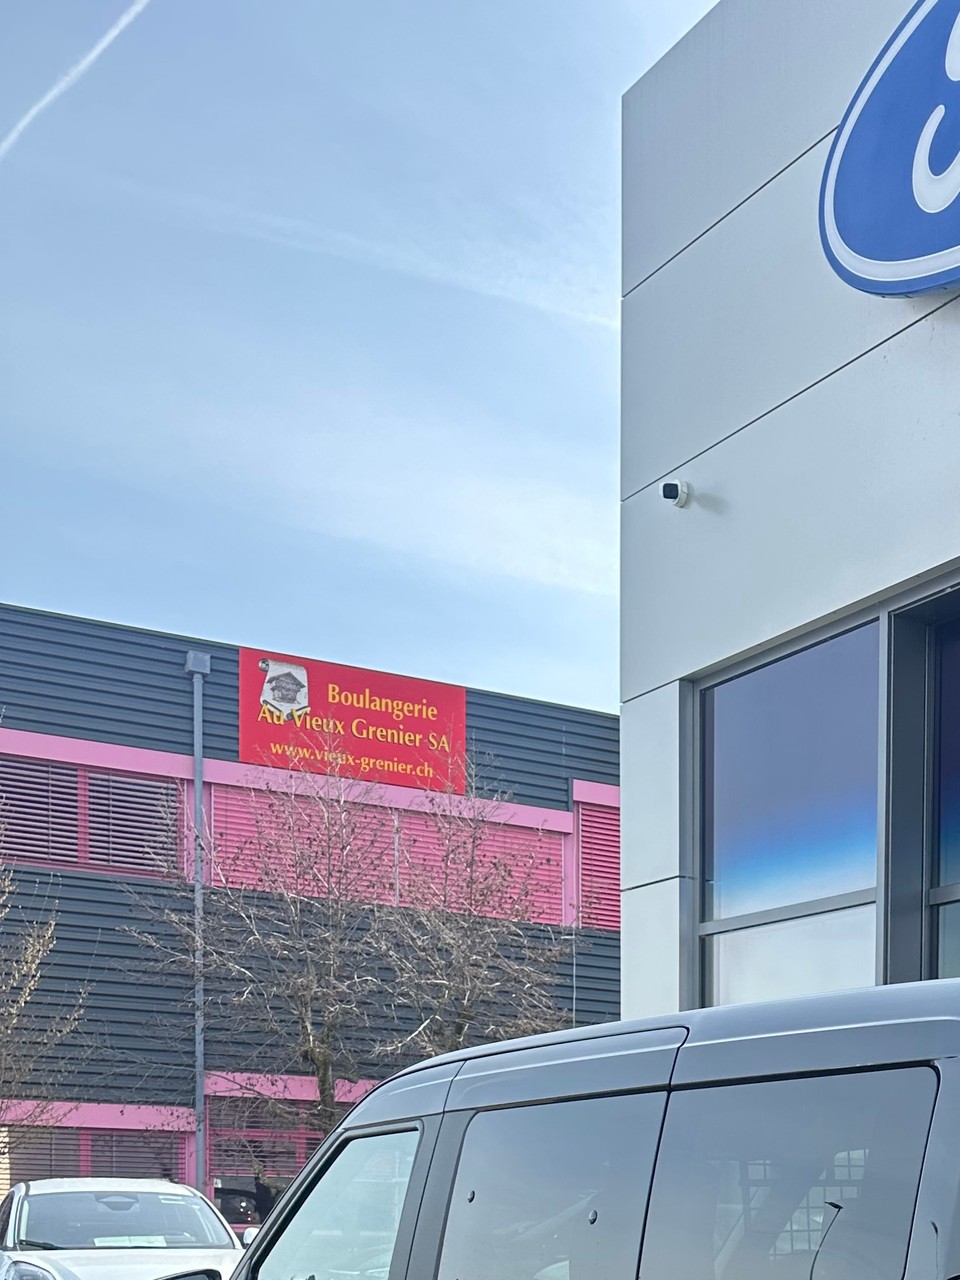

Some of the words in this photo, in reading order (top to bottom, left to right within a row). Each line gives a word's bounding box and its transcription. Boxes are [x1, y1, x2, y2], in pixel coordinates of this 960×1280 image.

[327, 683, 438, 721] Boulangerie
[257, 703, 285, 726] Au
[292, 706, 345, 736] Vieux
[351, 718, 423, 747] Grenier
[428, 732, 450, 753] SA
[270, 742, 434, 778] www.vieux-grenier.ch
